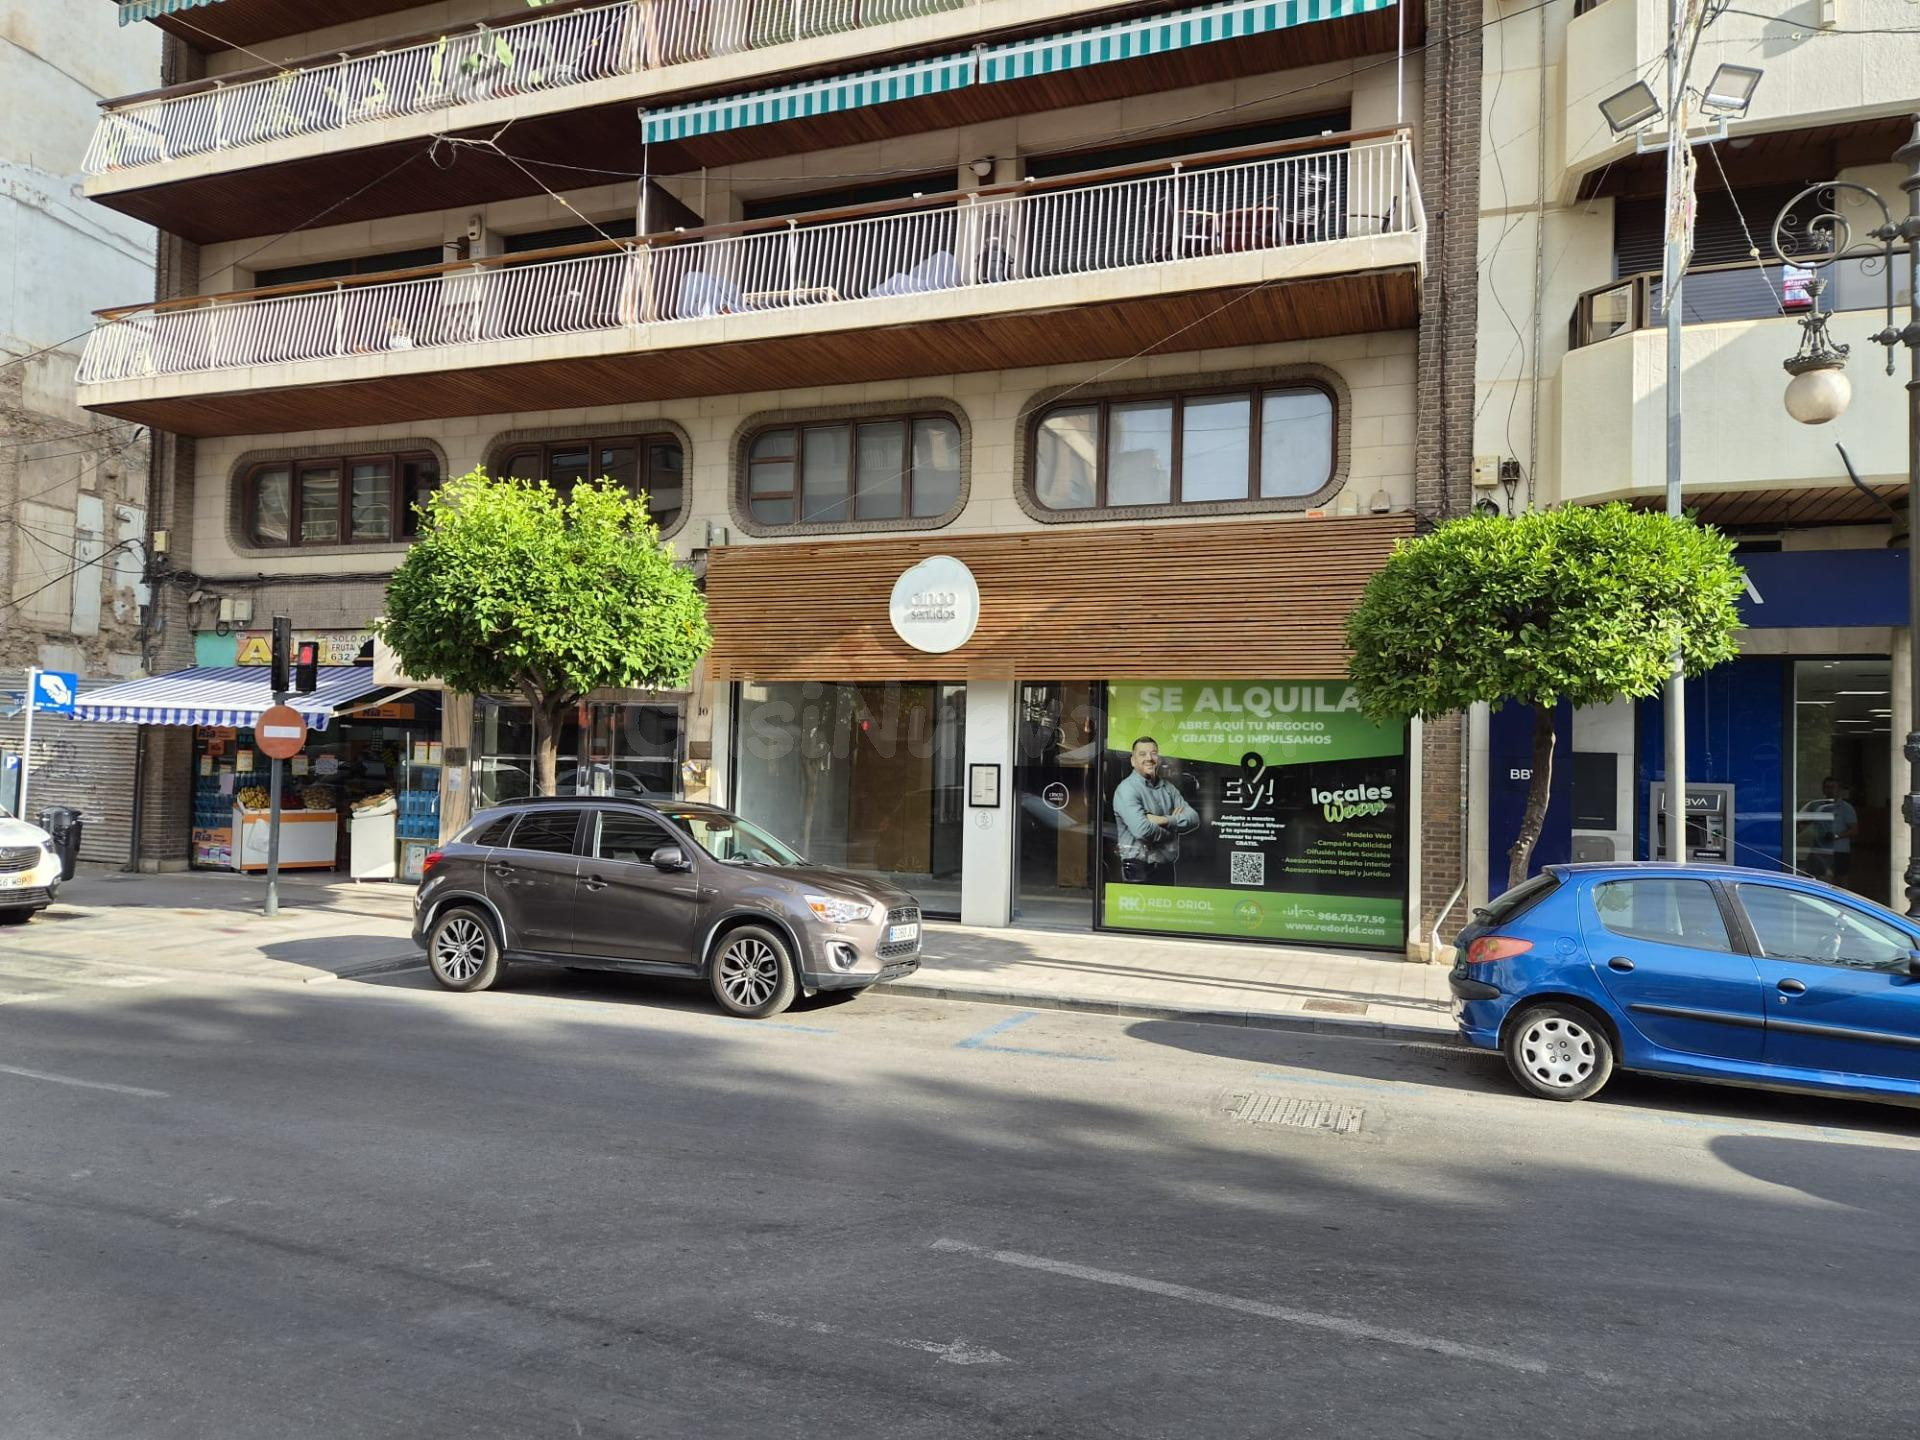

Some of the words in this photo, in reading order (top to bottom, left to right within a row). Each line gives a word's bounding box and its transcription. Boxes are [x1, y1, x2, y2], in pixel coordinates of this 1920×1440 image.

[331, 643, 354, 651] FRUTA
[331, 653, 350, 661] 632
[1139, 687, 1183, 713] SE
[1194, 686, 1362, 718] ALQUILA
[698, 707, 709, 717] 10
[1177, 721, 1210, 732] ABRE
[1213, 719, 1244, 733] AQUÍ
[1247, 722, 1262, 732] TU
[1266, 722, 1325, 732] NEGOCIO
[1172, 735, 1181, 743] Y
[1182, 734, 1224, 743] GRATIS
[1228, 735, 1243, 744] LO
[1247, 735, 1332, 745] IMPULSAMOS
[6, 756, 18, 769] P
[1510, 769, 1533, 780] BB
[1311, 784, 1393, 805] locales
[1353, 841, 1392, 849] Publicidad
[1339, 858, 1362, 866] diseño
[1364, 860, 1391, 868] interior
[1339, 869, 1356, 877] legal
[1363, 870, 1391, 878] jurídico
[1148, 898, 1172, 908] RED
[1176, 899, 1215, 911] ORIOL
[1318, 912, 1386, 924] 966.73.77.50
[1285, 922, 1385, 936] www.redoriol.com
